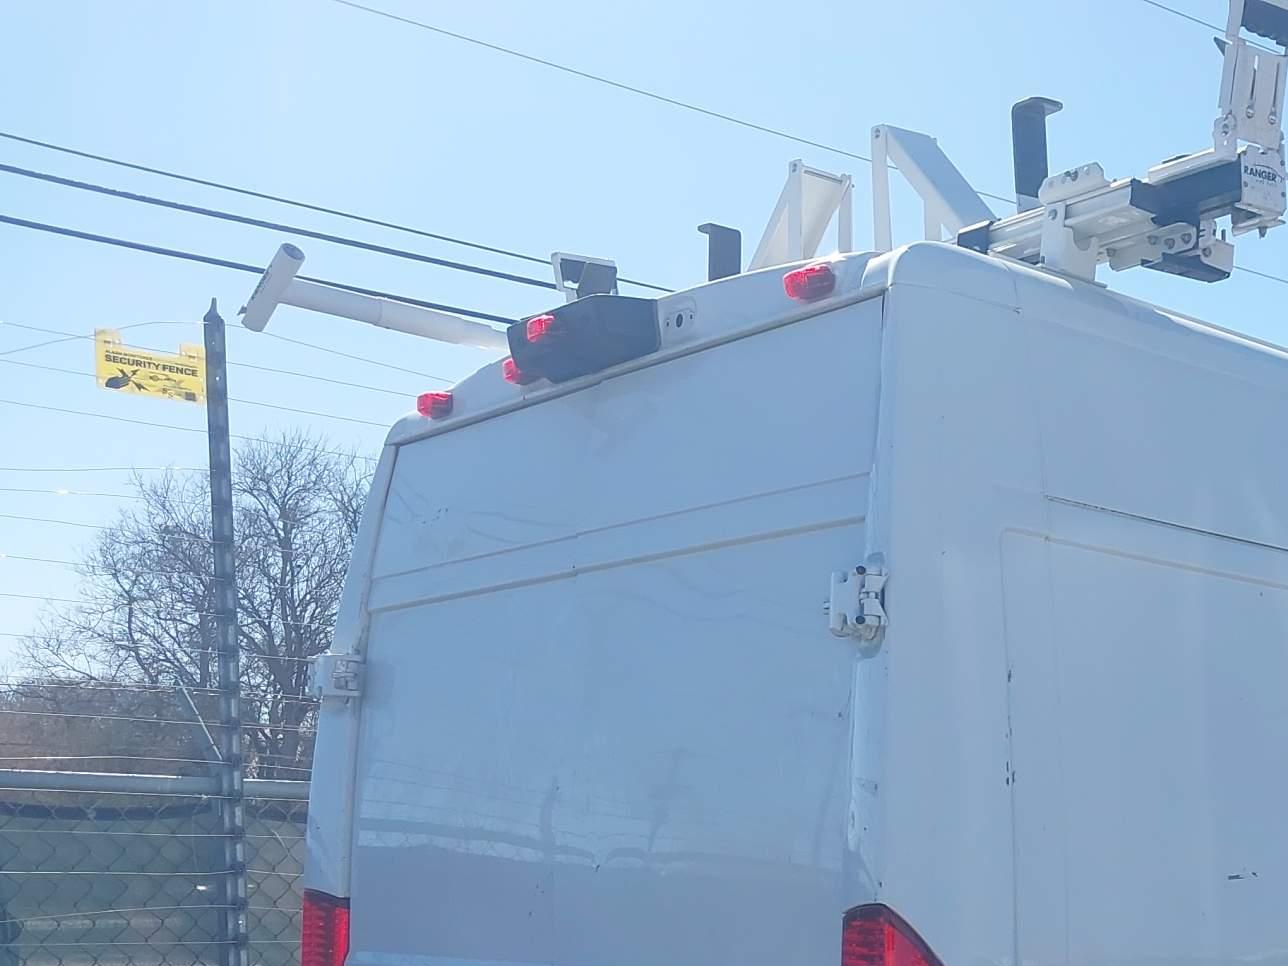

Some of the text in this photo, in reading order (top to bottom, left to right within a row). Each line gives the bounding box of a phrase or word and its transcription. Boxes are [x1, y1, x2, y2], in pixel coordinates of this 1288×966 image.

[1244, 165, 1277, 183] RANGER
[104, 353, 199, 377] SECURITY FENCE
